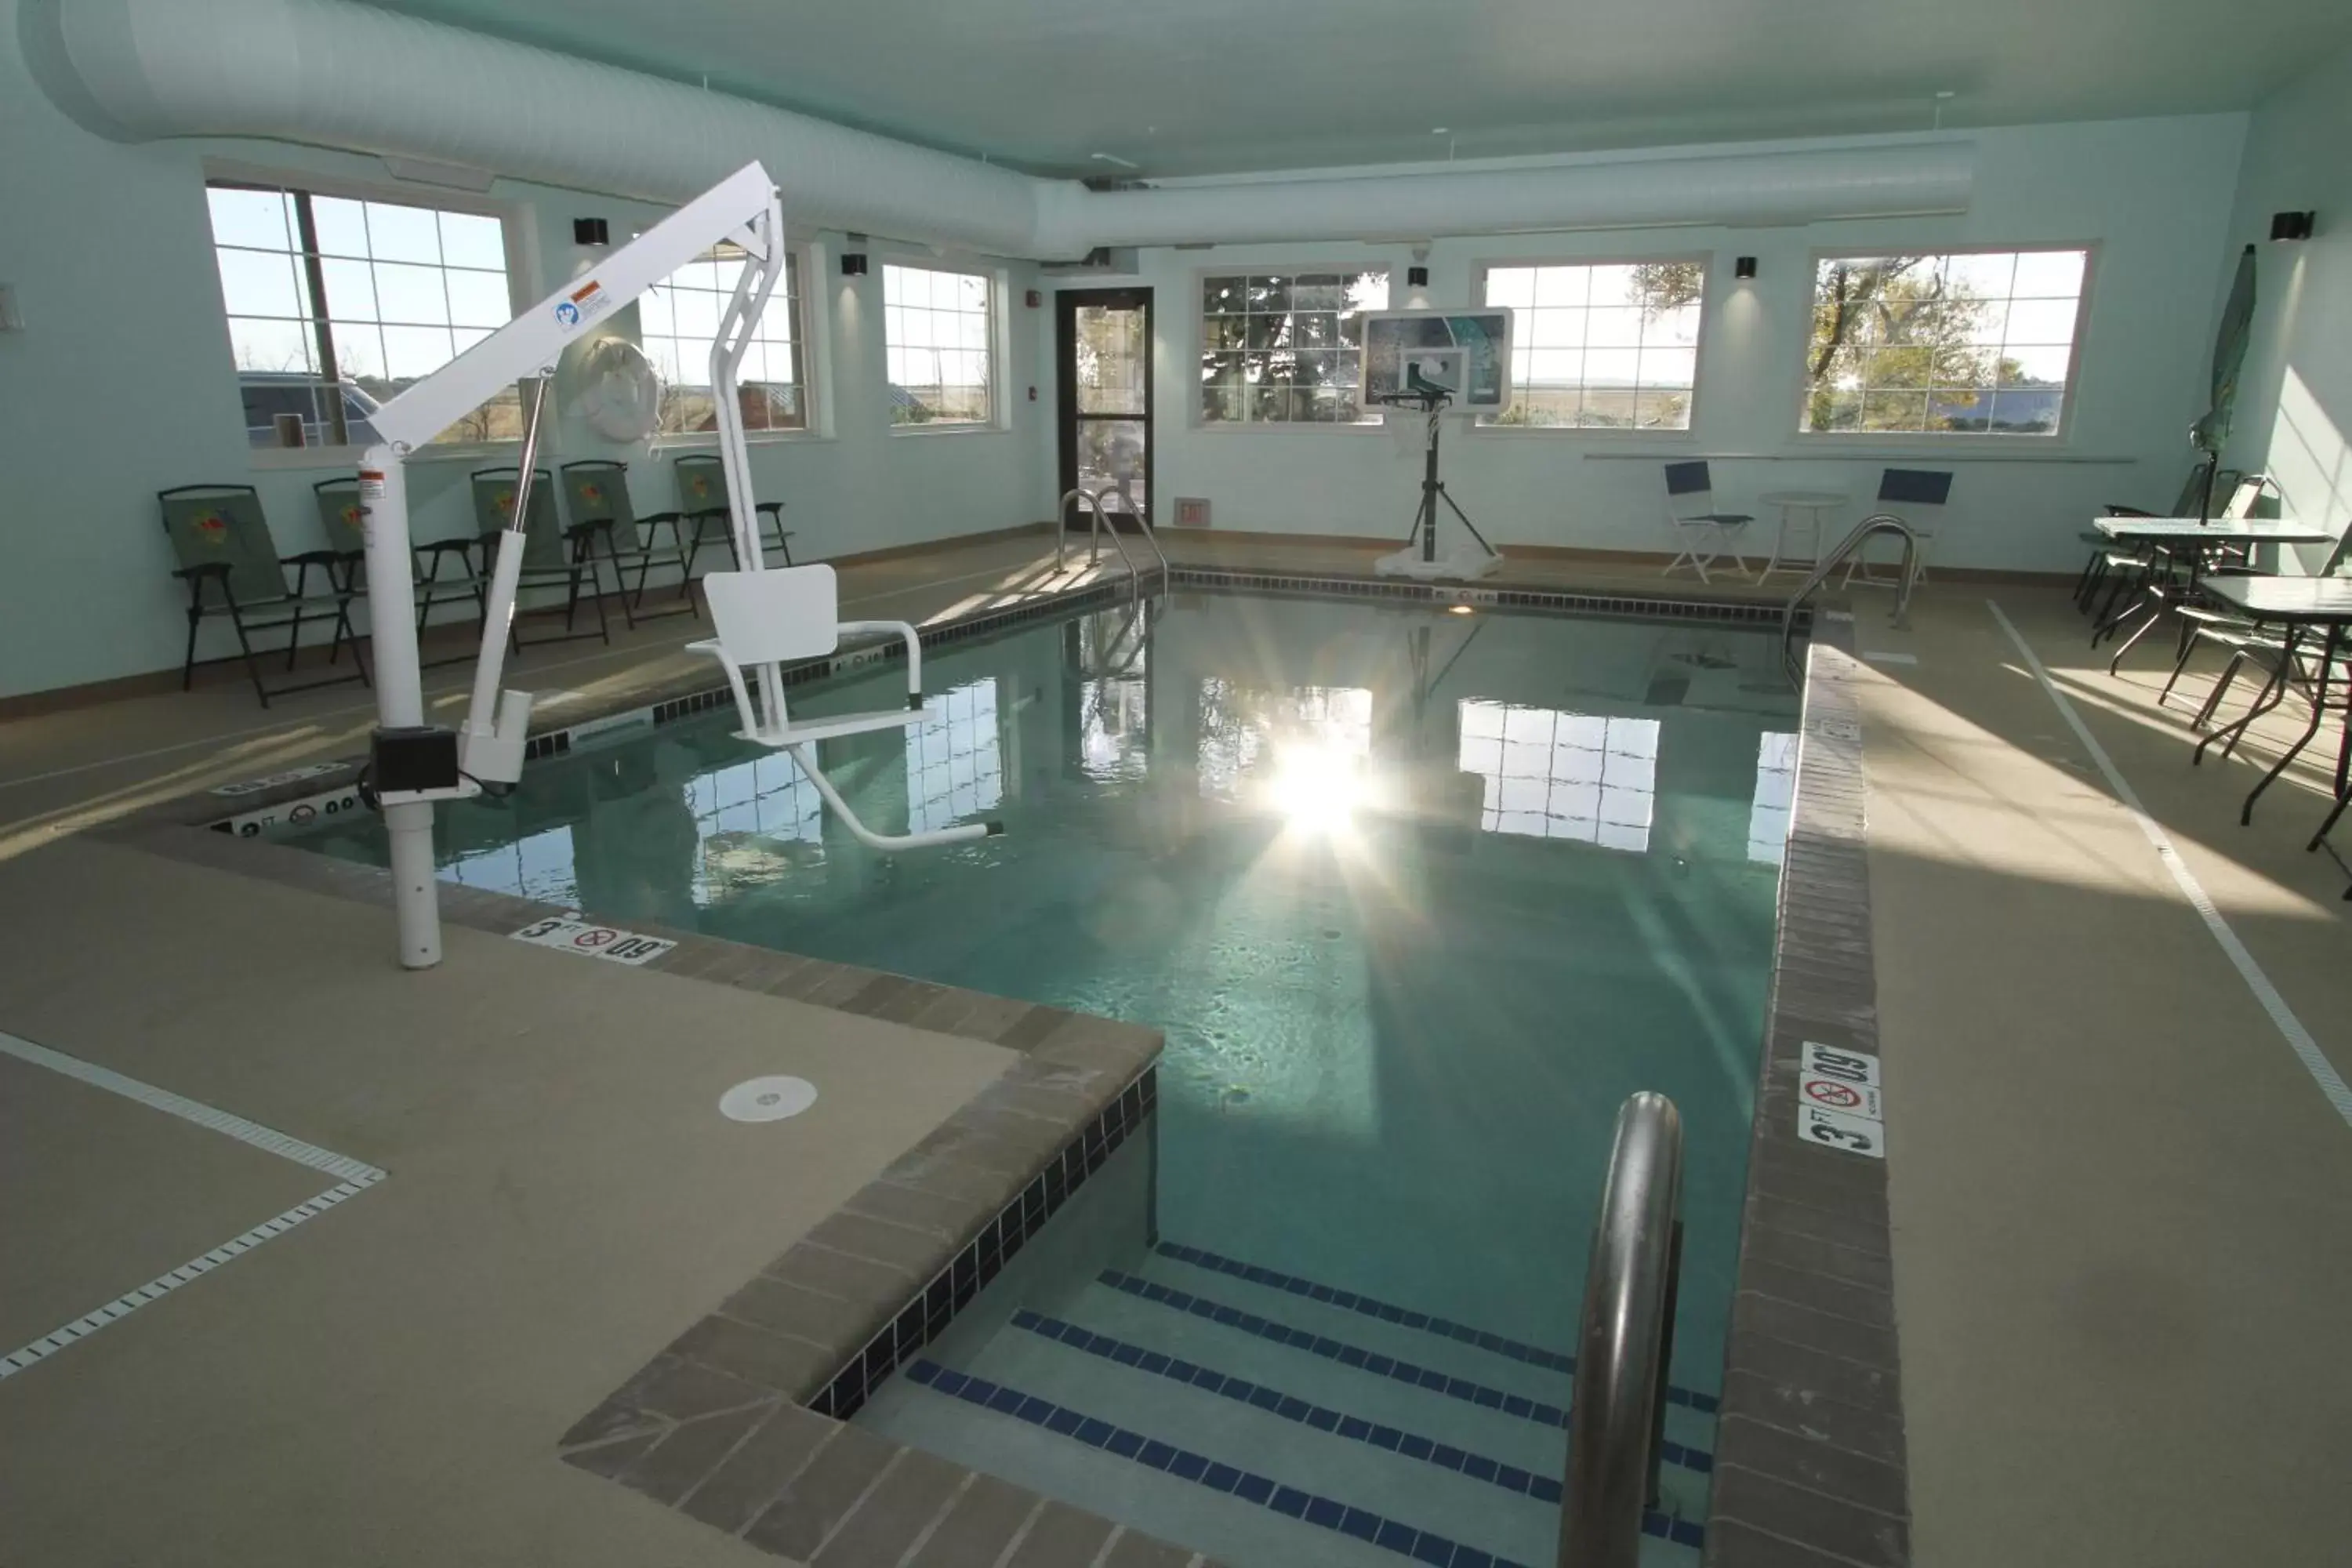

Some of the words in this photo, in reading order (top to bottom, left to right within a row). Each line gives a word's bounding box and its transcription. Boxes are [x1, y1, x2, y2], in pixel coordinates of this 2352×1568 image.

[521, 921, 561, 938] 3
[1810, 1109, 1832, 1124] FT
[1810, 1123, 1872, 1150] 3
